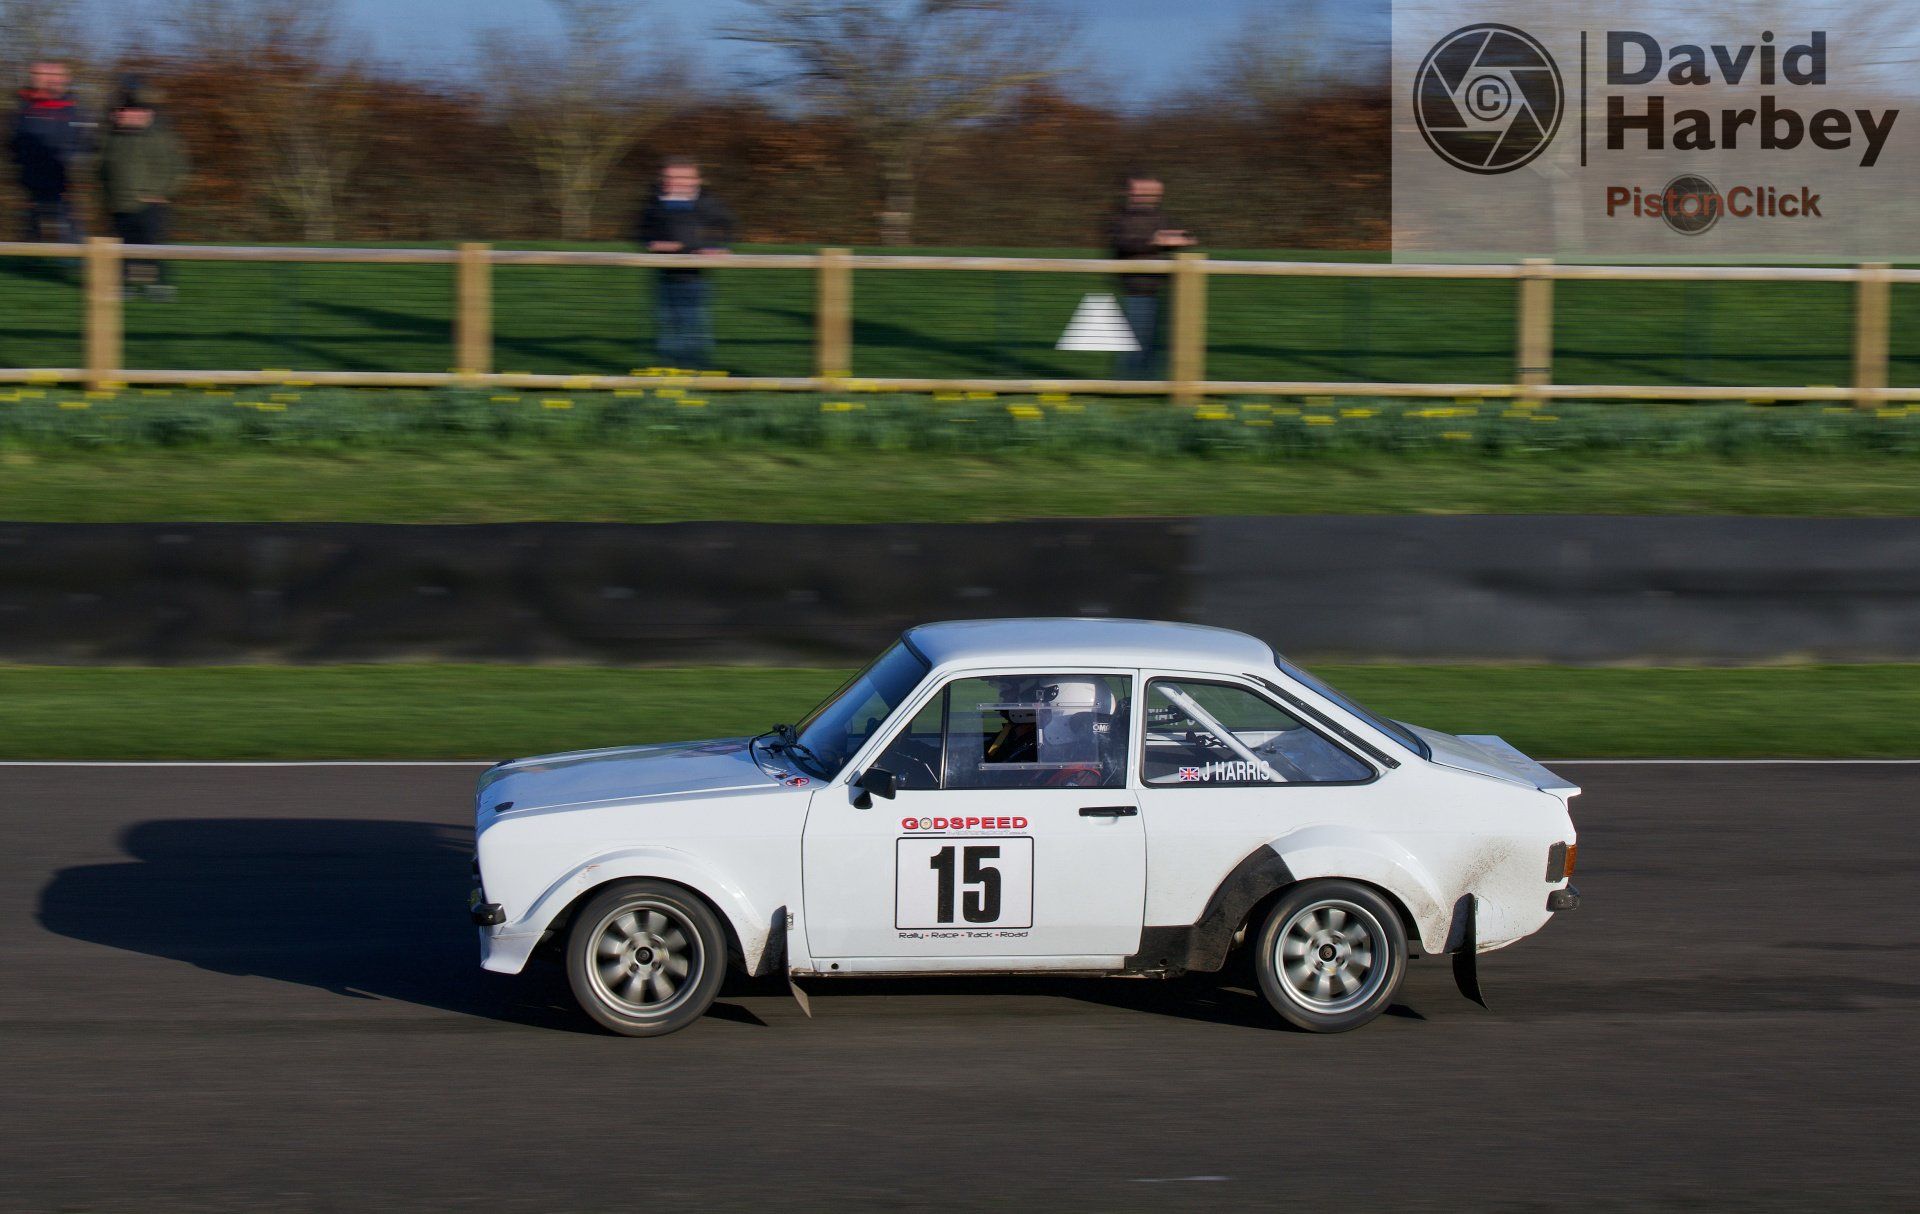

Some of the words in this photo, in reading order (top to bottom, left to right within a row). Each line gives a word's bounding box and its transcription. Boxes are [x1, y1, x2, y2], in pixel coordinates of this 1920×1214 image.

[1202, 761, 1210, 781] J
[1215, 760, 1270, 781] HARRIS
[901, 816, 1028, 830] GODSPEED
[930, 845, 1001, 923] 15
